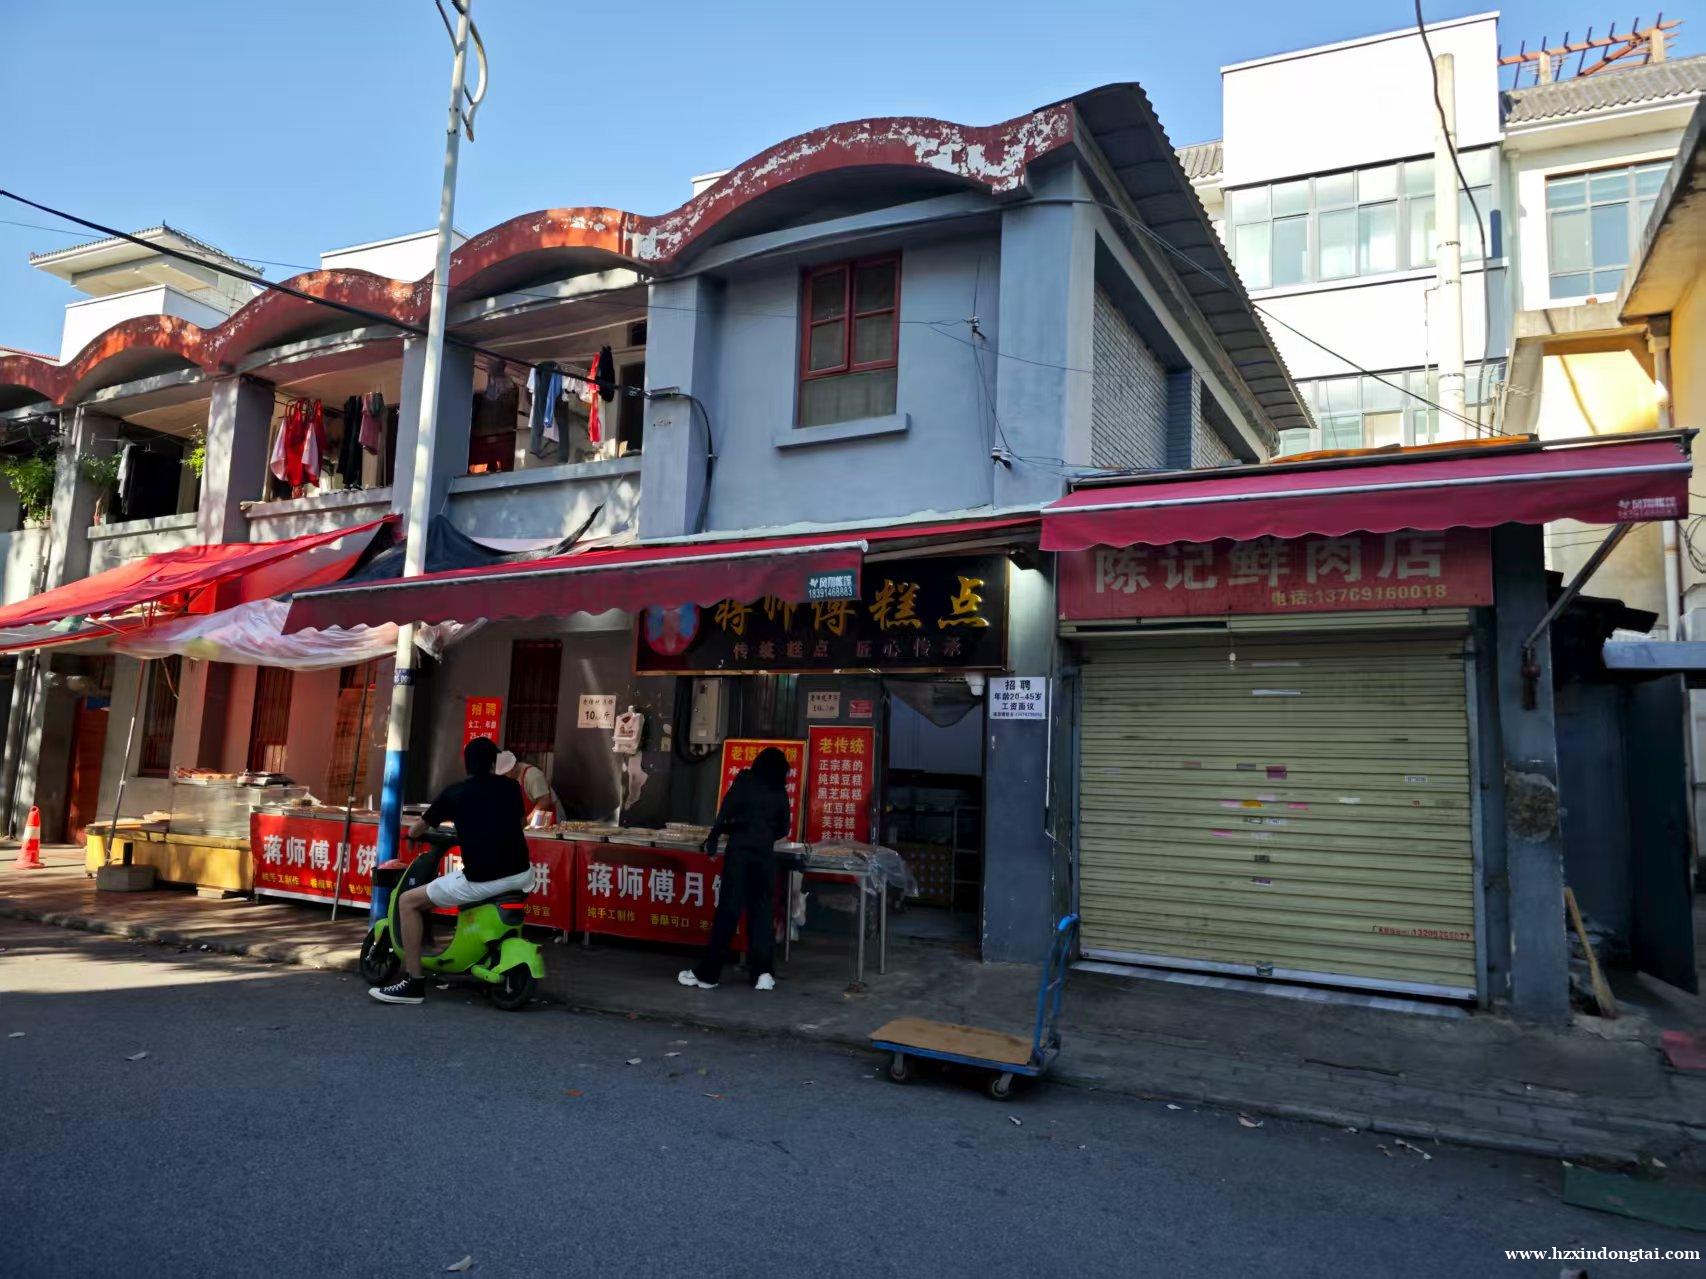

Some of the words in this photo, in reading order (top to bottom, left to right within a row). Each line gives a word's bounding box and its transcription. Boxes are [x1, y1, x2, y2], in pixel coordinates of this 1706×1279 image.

[1096, 531, 1446, 594] 陈记鲜肉店
[1005, 680, 1031, 690] 招聘
[994, 692, 1042, 701] 年龄20-45岁
[471, 702, 497, 716] 招聘
[1002, 702, 1035, 711] 工资面议
[819, 736, 865, 755] 老传统
[819, 758, 863, 772] 正宗蒸的
[817, 773, 863, 786] 纯绿豆糕
[817, 787, 863, 800] 黑芝麻糕
[823, 801, 857, 815] 红豆糕
[262, 834, 377, 878] 蒋师傅月饼
[587, 905, 637, 922] 纯手工制作
